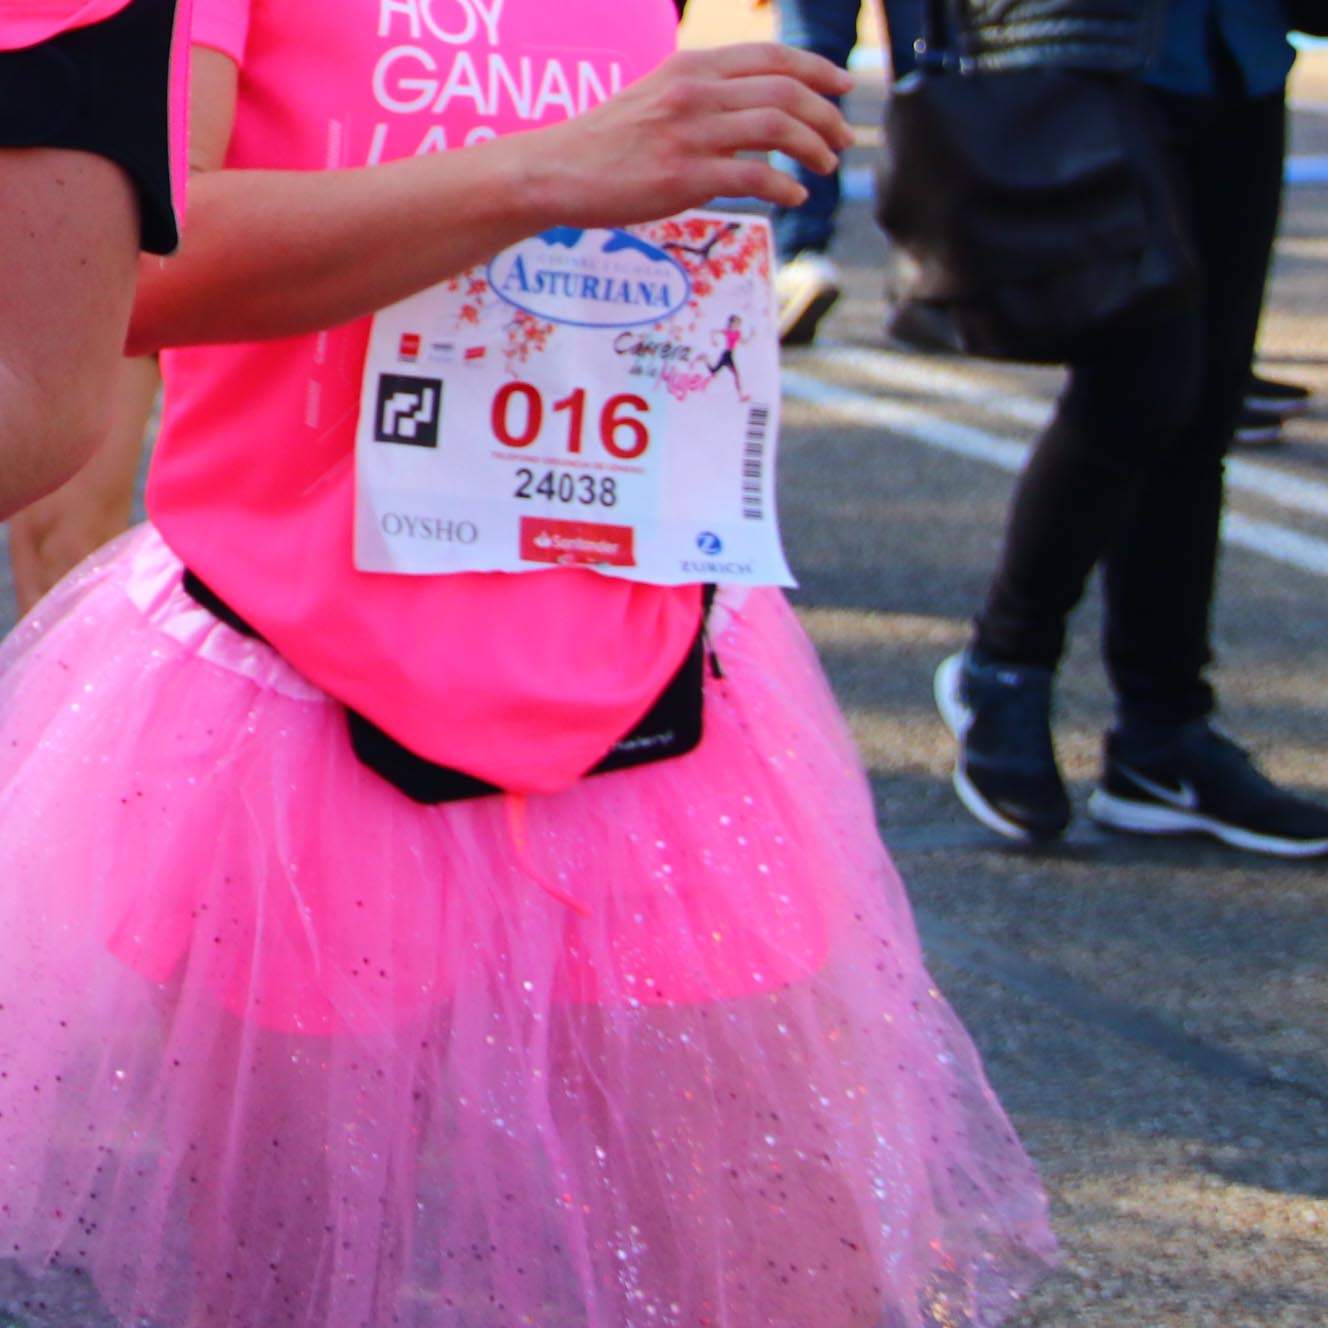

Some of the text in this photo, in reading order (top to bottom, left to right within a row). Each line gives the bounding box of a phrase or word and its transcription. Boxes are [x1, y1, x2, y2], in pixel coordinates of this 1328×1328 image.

[372, 45, 624, 120] GANAN
[501, 253, 671, 308] ASTURIANA
[491, 381, 650, 460] 016
[514, 468, 617, 507] 24038
[381, 511, 480, 545] OYSHO
[552, 533, 621, 555] Santander
[680, 556, 753, 576] ZURICH
